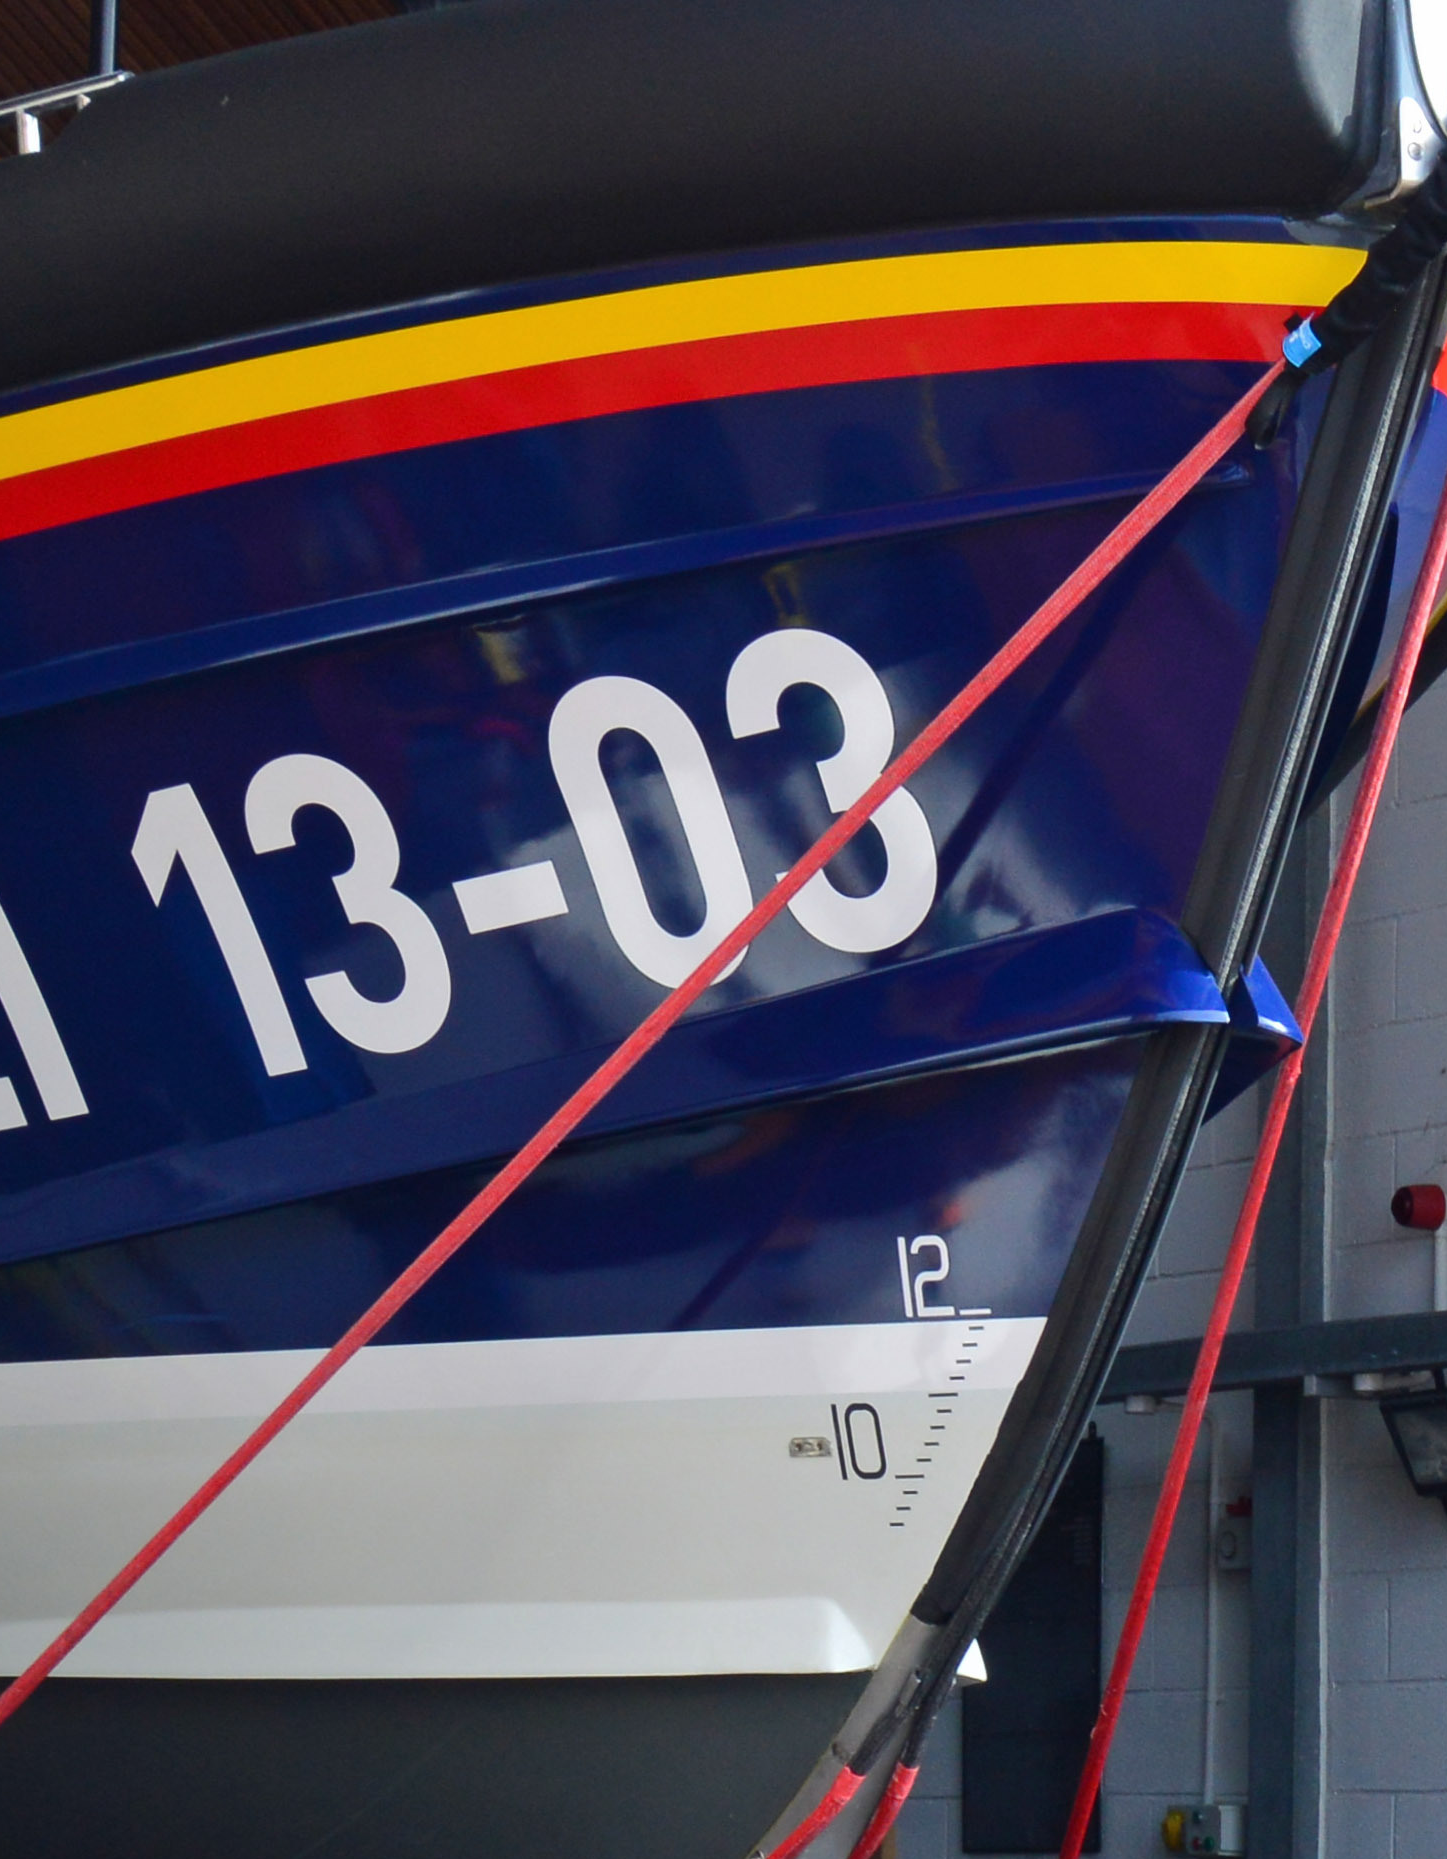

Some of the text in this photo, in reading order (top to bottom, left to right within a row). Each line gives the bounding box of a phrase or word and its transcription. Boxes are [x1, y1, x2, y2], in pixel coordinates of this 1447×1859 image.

[131, 629, 938, 1077] 13-03
[897, 1234, 956, 1318] 12
[830, 1403, 887, 1481] 10
